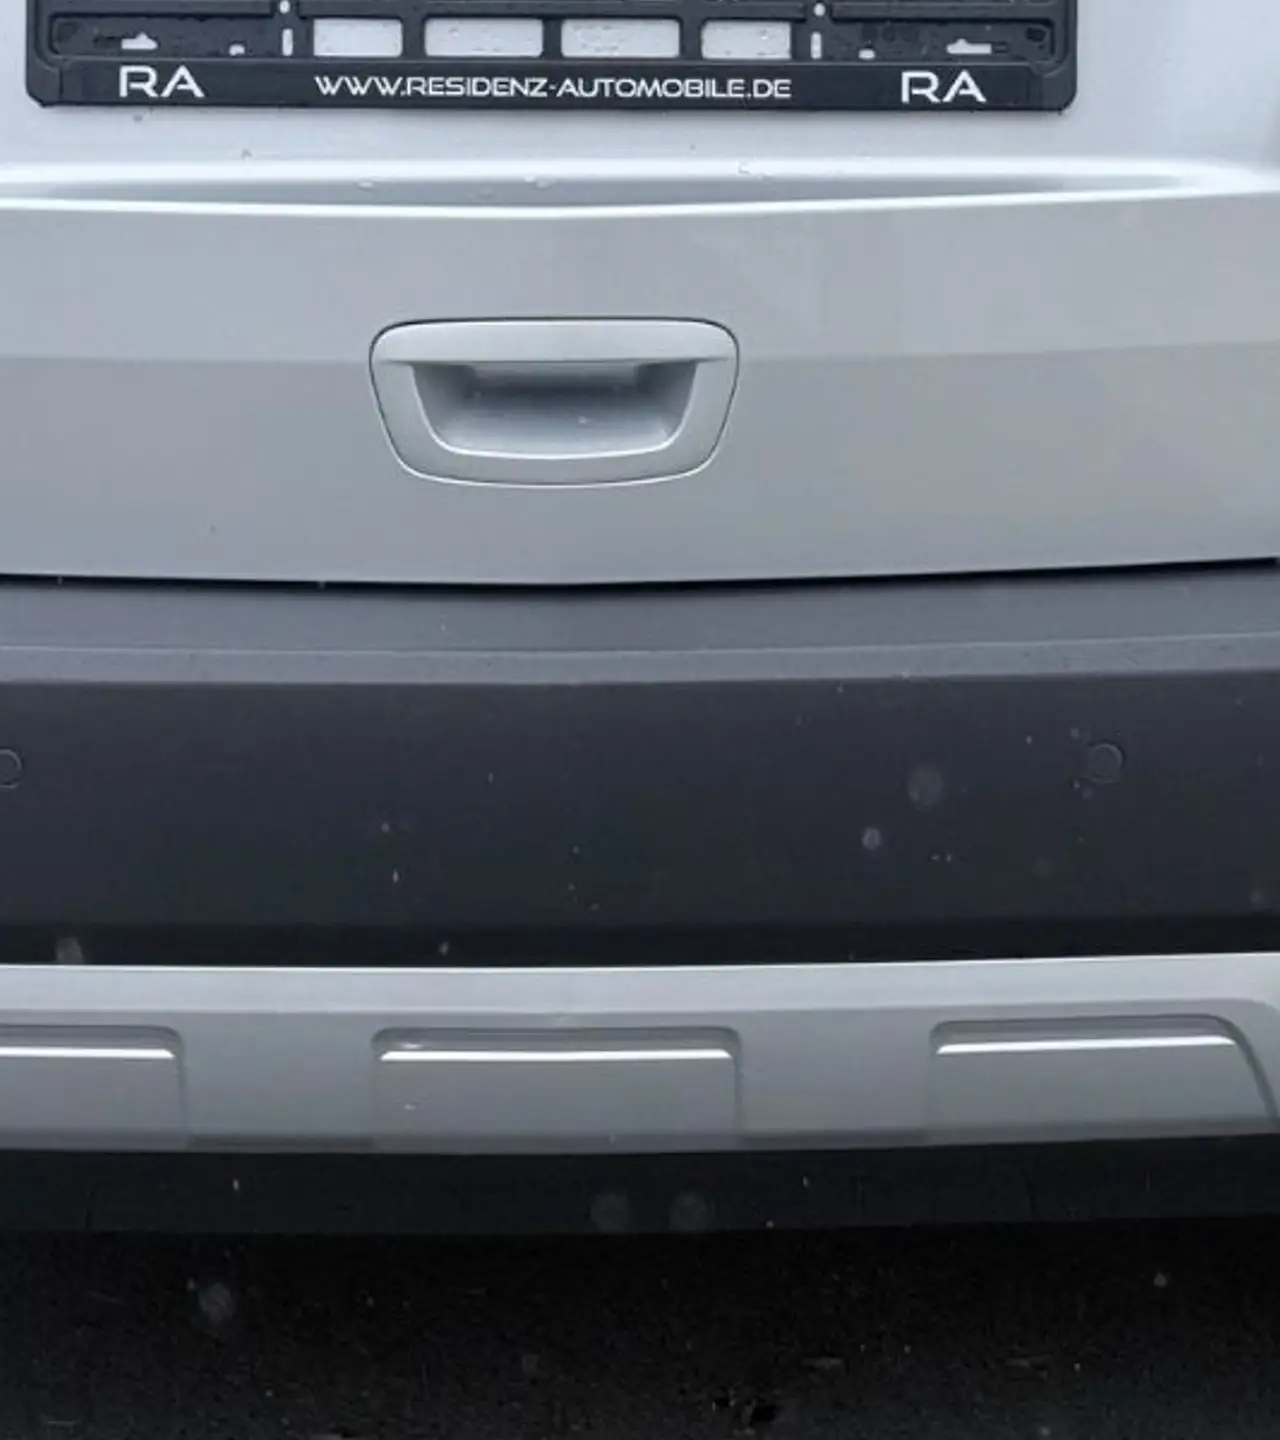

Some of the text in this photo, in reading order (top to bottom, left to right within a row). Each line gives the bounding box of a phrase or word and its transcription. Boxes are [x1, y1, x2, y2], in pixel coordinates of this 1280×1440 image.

[118, 65, 987, 103] RA WWW.RESIDENZ-AUTOMOBILE.DE RA
